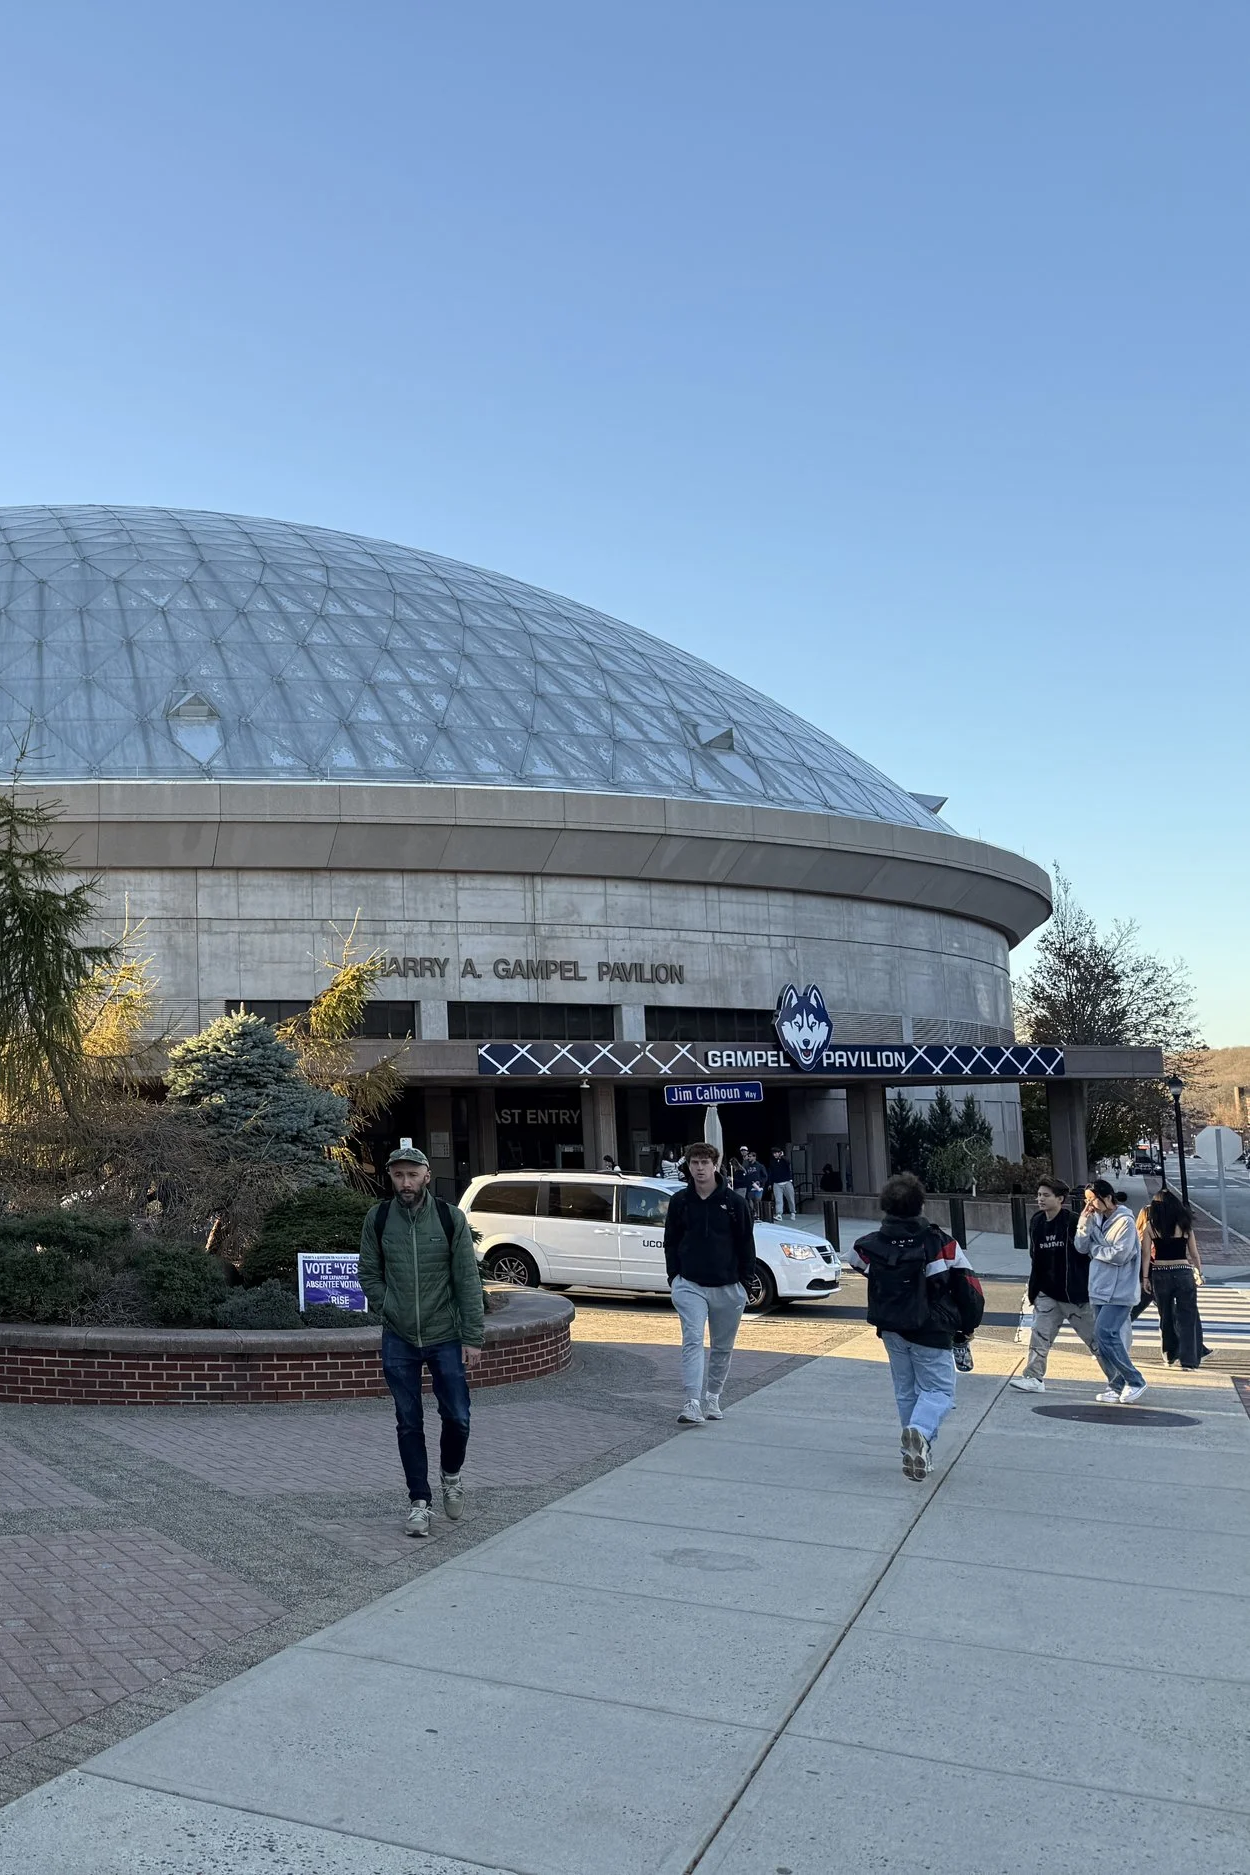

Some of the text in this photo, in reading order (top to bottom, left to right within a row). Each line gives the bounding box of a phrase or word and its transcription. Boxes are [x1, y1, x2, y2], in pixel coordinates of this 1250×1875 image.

[461, 958, 482, 979] A.
[493, 958, 587, 982] GAMPEL
[598, 961, 684, 985] PAVILION
[707, 1050, 906, 1068] GAMPEL PAVILION
[671, 1085, 757, 1102] Jim Calhoun Way
[526, 1109, 581, 1124] ENTRY
[642, 1240, 665, 1248] UCO
[305, 1262, 332, 1275] VOTE
[306, 1280, 340, 1289] ABSENTEE
[330, 1295, 350, 1305] RISE
